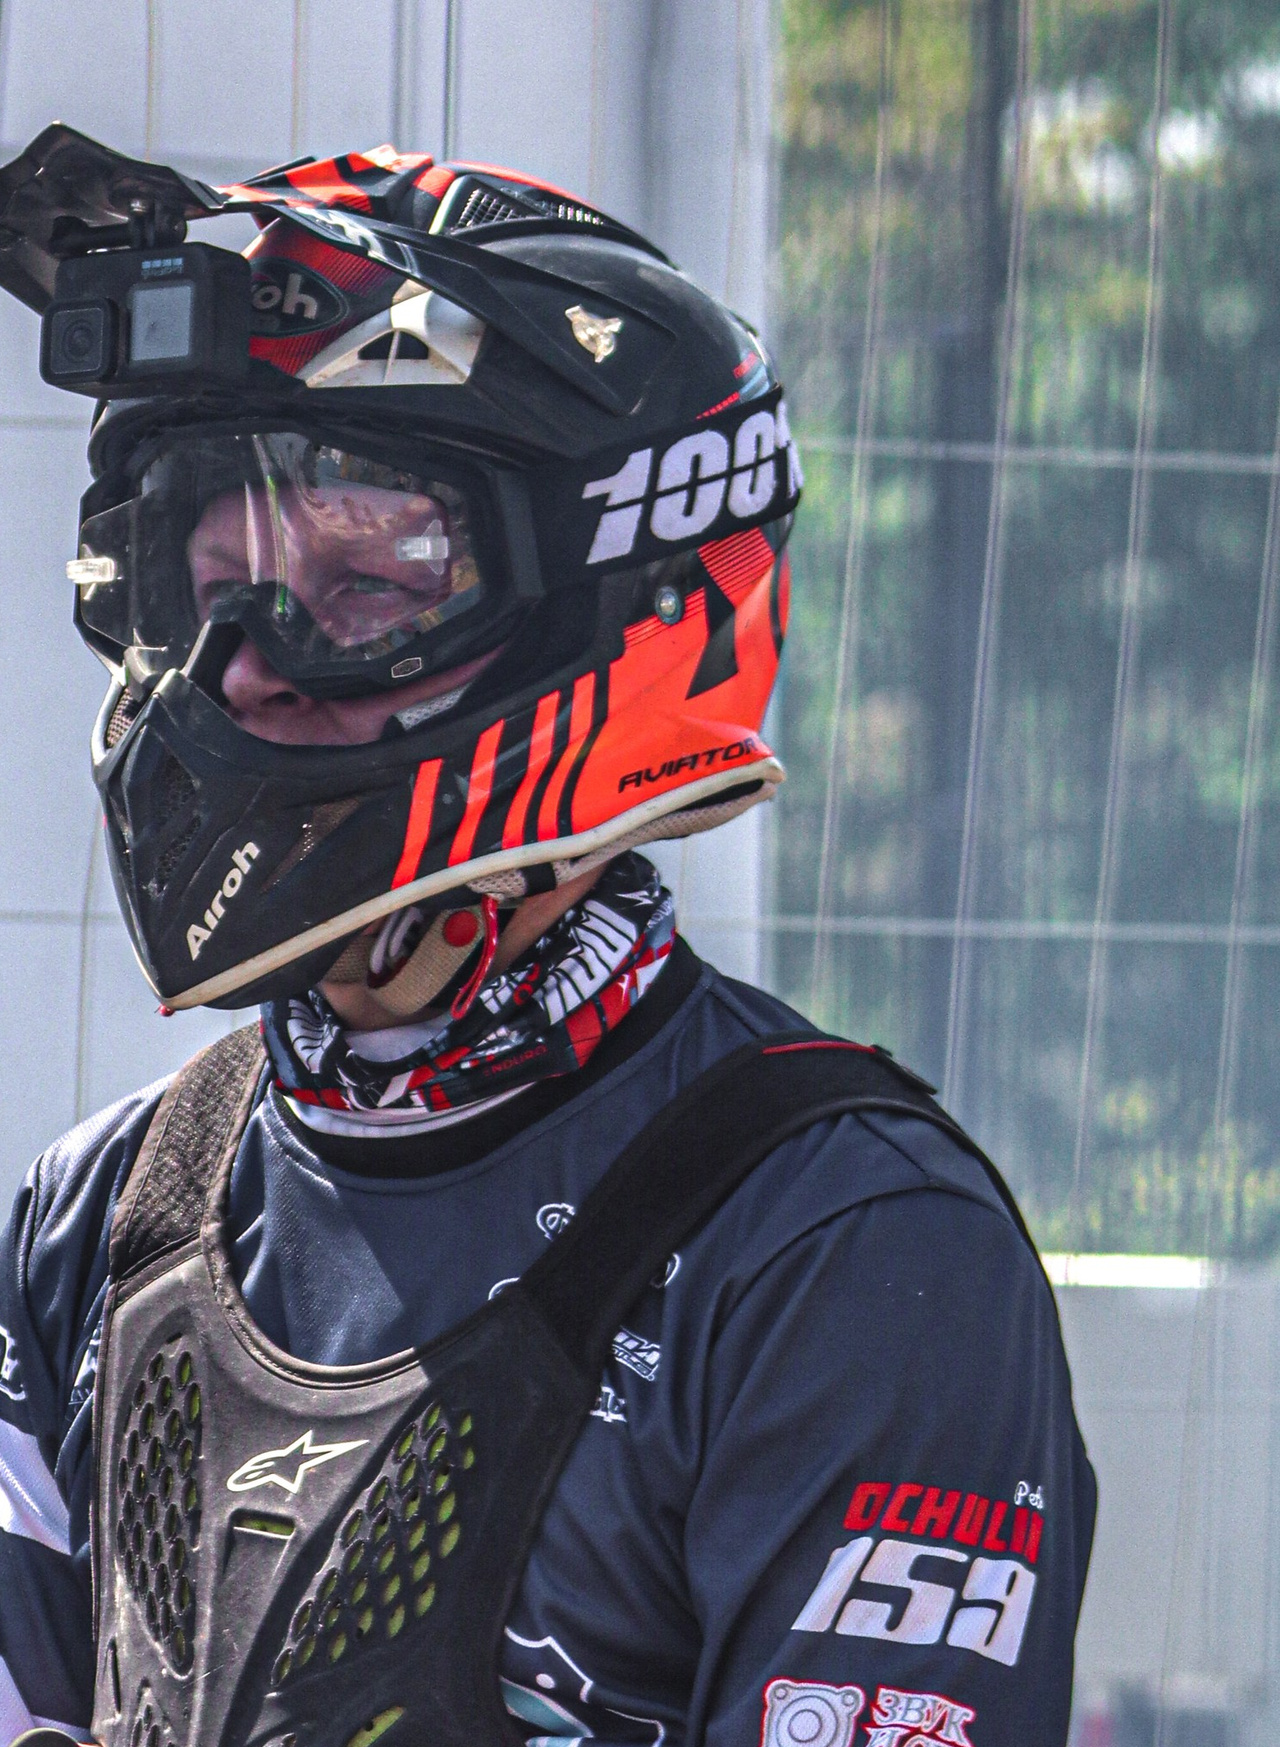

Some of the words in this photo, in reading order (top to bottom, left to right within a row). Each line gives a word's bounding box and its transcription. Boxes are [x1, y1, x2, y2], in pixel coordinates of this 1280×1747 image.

[618, 737, 756, 793] AVIATOR
[186, 841, 260, 961] Airoh
[791, 1536, 1036, 1667] 159
[875, 1691, 973, 1746] ЗВУК
